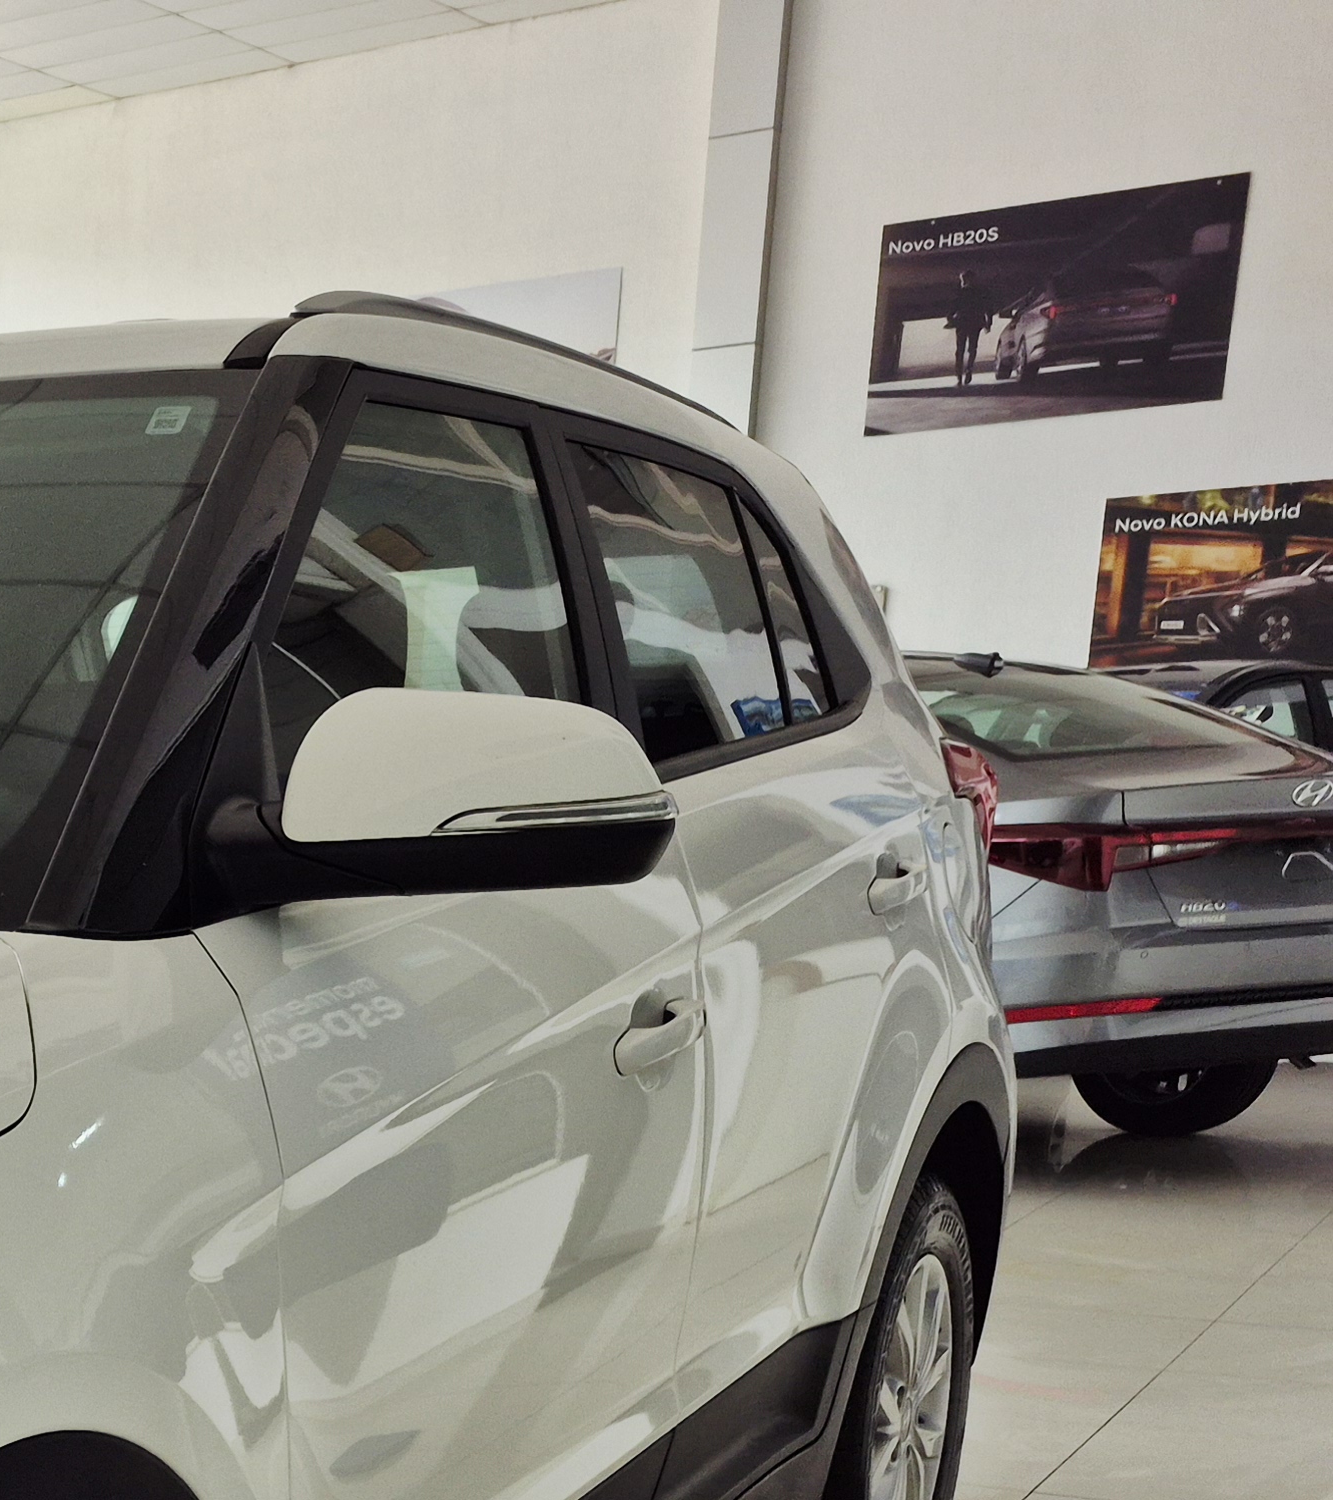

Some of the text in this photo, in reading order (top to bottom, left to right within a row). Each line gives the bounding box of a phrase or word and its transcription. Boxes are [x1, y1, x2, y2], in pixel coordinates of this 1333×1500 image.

[888, 226, 999, 255] Novo HB20S
[1114, 502, 1301, 533] Novo KONA Hybrid
